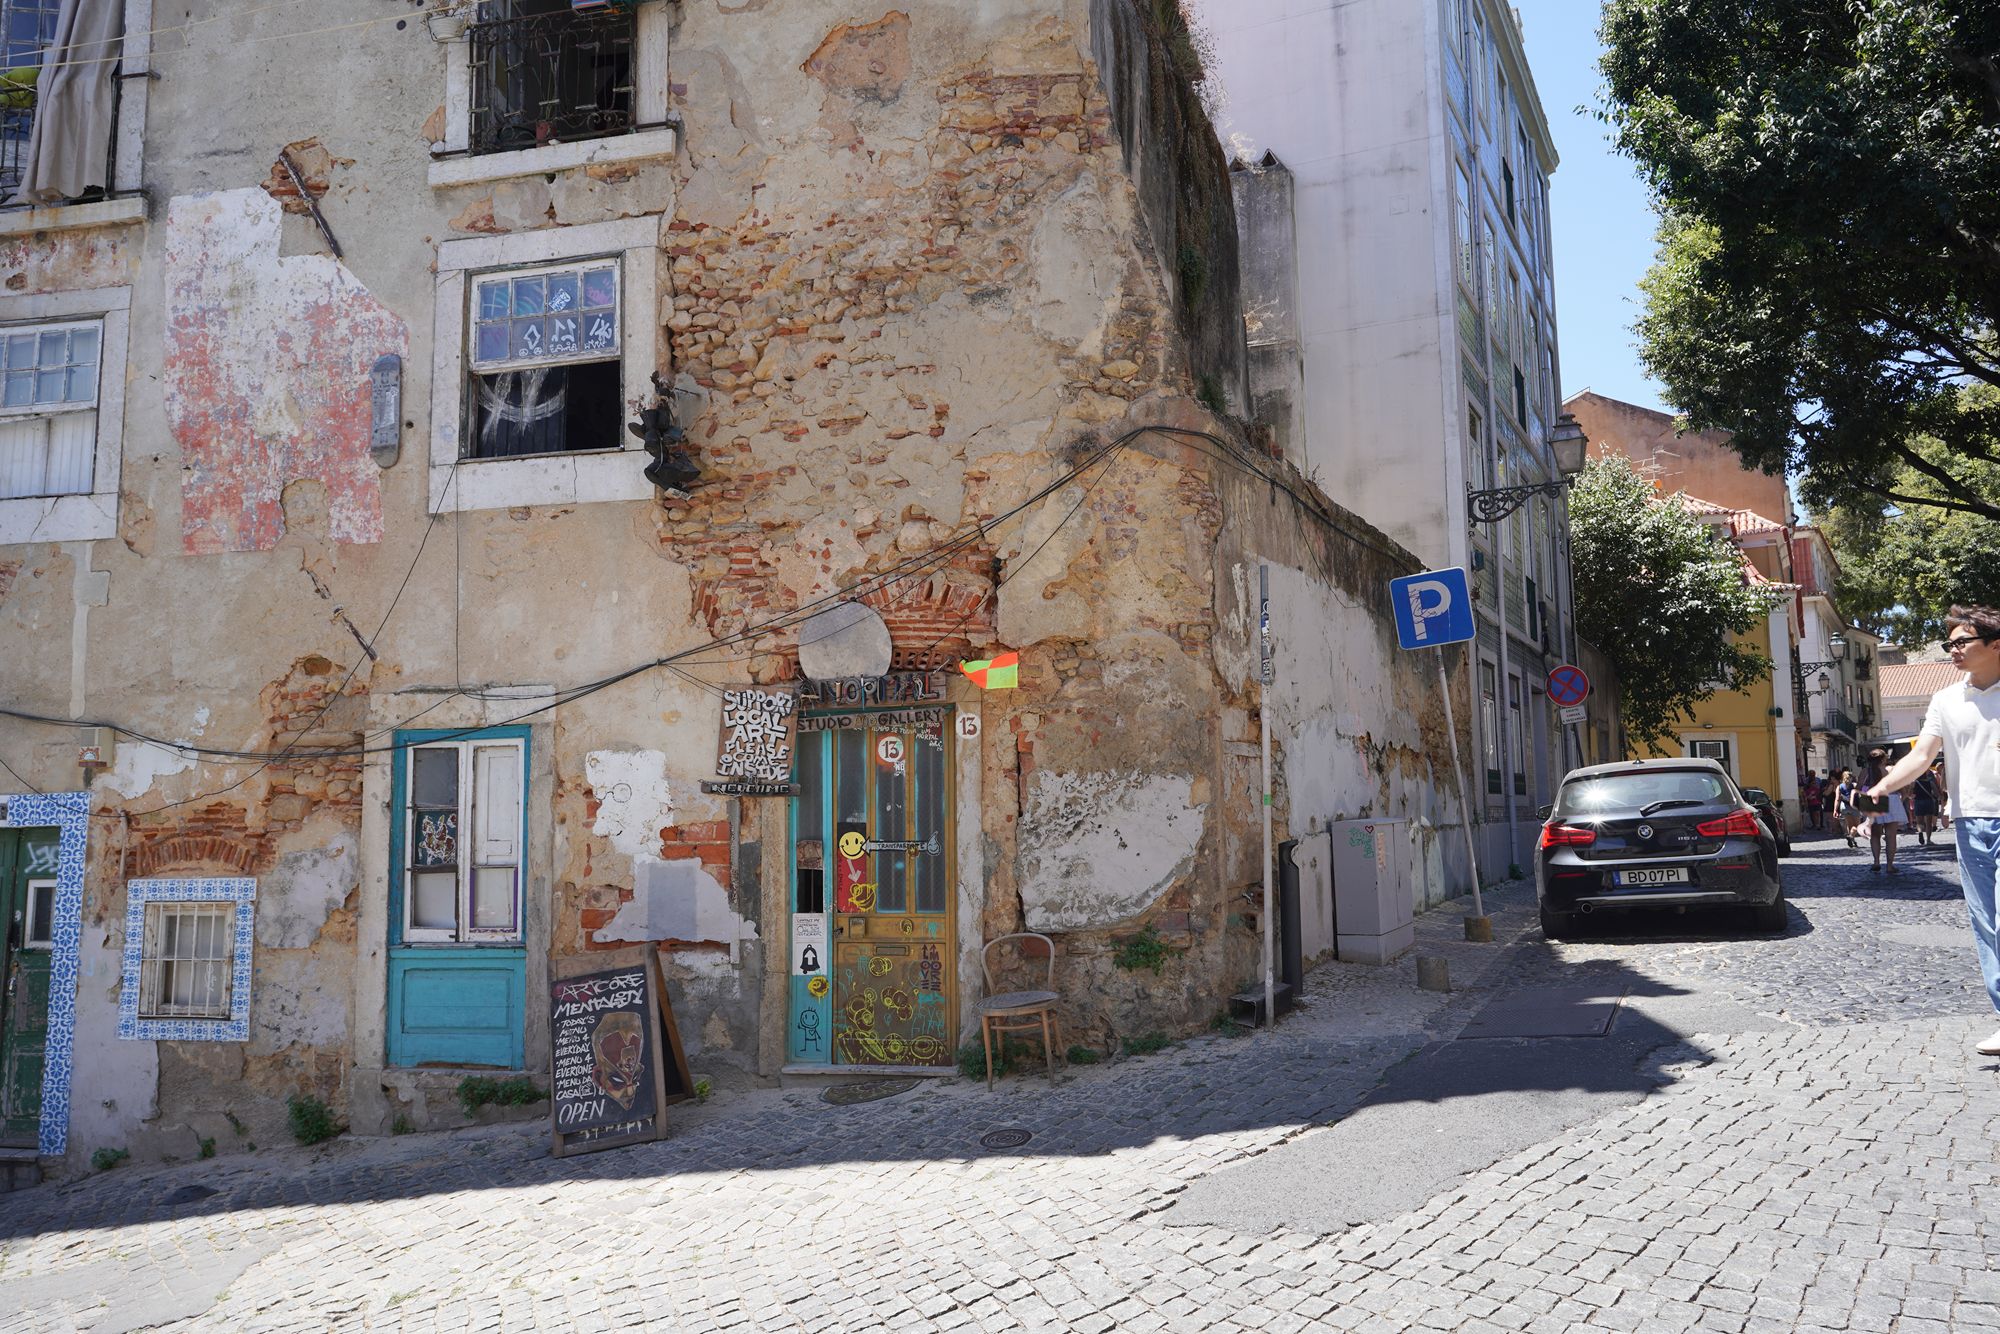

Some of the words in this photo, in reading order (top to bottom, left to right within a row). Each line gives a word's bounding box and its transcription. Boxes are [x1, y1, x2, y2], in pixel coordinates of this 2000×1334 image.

[1408, 580, 1451, 640] P
[724, 690, 792, 716] SUPPORT
[723, 709, 787, 732] LOCAL
[798, 717, 852, 731] STUDIO
[878, 709, 942, 726] GALLERY
[960, 716, 977, 735] 13
[731, 724, 786, 747] ART
[725, 740, 789, 760] PLEASE
[882, 740, 900, 759] 13
[716, 762, 789, 780] INSIDE
[560, 973, 645, 1000] ARTCORE
[561, 1015, 595, 1028] TODAY'S
[582, 1033, 590, 1041] 4
[555, 1042, 590, 1057] EVERYDAY
[585, 1053, 592, 1063] 4
[555, 1063, 593, 1079] EVERYONE
[558, 1099, 605, 1124] OPEN
